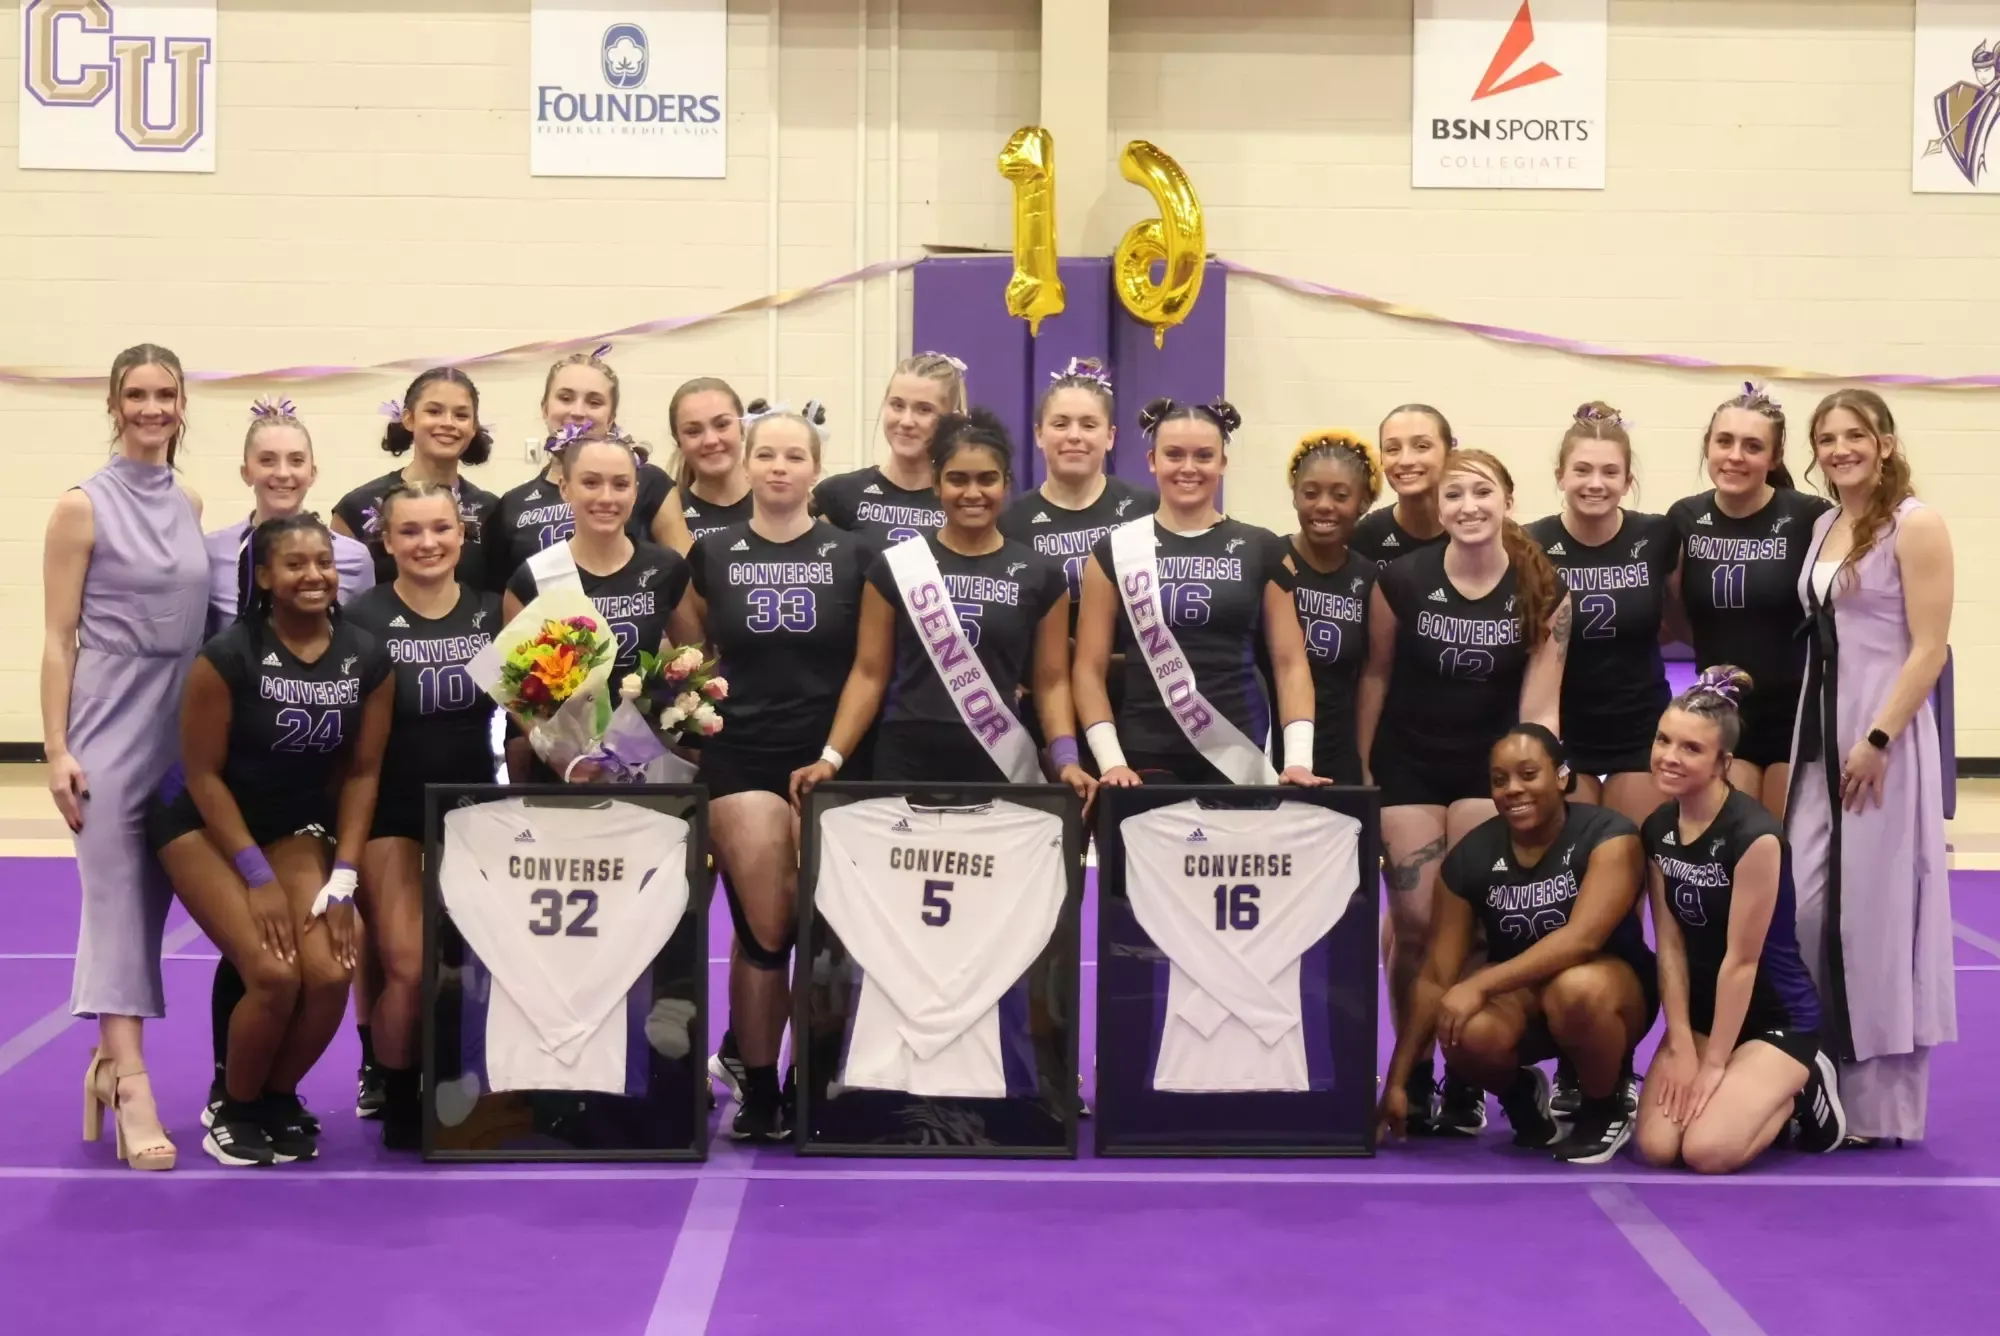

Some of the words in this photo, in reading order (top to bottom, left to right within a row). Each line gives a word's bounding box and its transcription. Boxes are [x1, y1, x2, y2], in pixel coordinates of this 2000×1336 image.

[25, 0, 211, 152] CU
[537, 86, 721, 123] FOUNDERS
[537, 125, 602, 135] FEDERAL
[611, 126, 665, 136] CREDIT
[673, 126, 719, 136] UNION
[1432, 118, 1491, 140] BSN
[1495, 119, 1589, 141] SPORTS
[1440, 156, 1578, 170] COLLEGIATE
[517, 502, 576, 529] CONVE
[856, 501, 948, 528] CONVERS
[1687, 533, 1787, 561] CONVERSE
[729, 562, 834, 585] CONVERSE
[1156, 556, 1242, 581] NVERSE
[1557, 561, 1650, 591] ONVERSE
[943, 574, 1019, 607] NVERSE
[1711, 564, 1745, 608] 11
[592, 591, 656, 620] VERSE
[746, 586, 817, 633] 33
[1296, 587, 1363, 623] NVERSE
[1579, 593, 1617, 640] 2
[1417, 611, 1522, 646] CONVERSE
[949, 667, 982, 692] 2026
[1156, 656, 1184, 680] 2026
[1439, 647, 1495, 682] 12
[260, 675, 360, 705] CONVERSE
[418, 664, 476, 715] 10
[270, 707, 344, 753] 24
[509, 854, 625, 882] CONVERSE
[889, 846, 996, 878] CONVERSE
[1184, 853, 1293, 877] CONVERSE
[921, 879, 955, 927] 5
[1486, 869, 1578, 911] CONVERSE
[1675, 882, 1708, 927] 9
[528, 887, 600, 937] 32
[1213, 884, 1261, 931] 16
